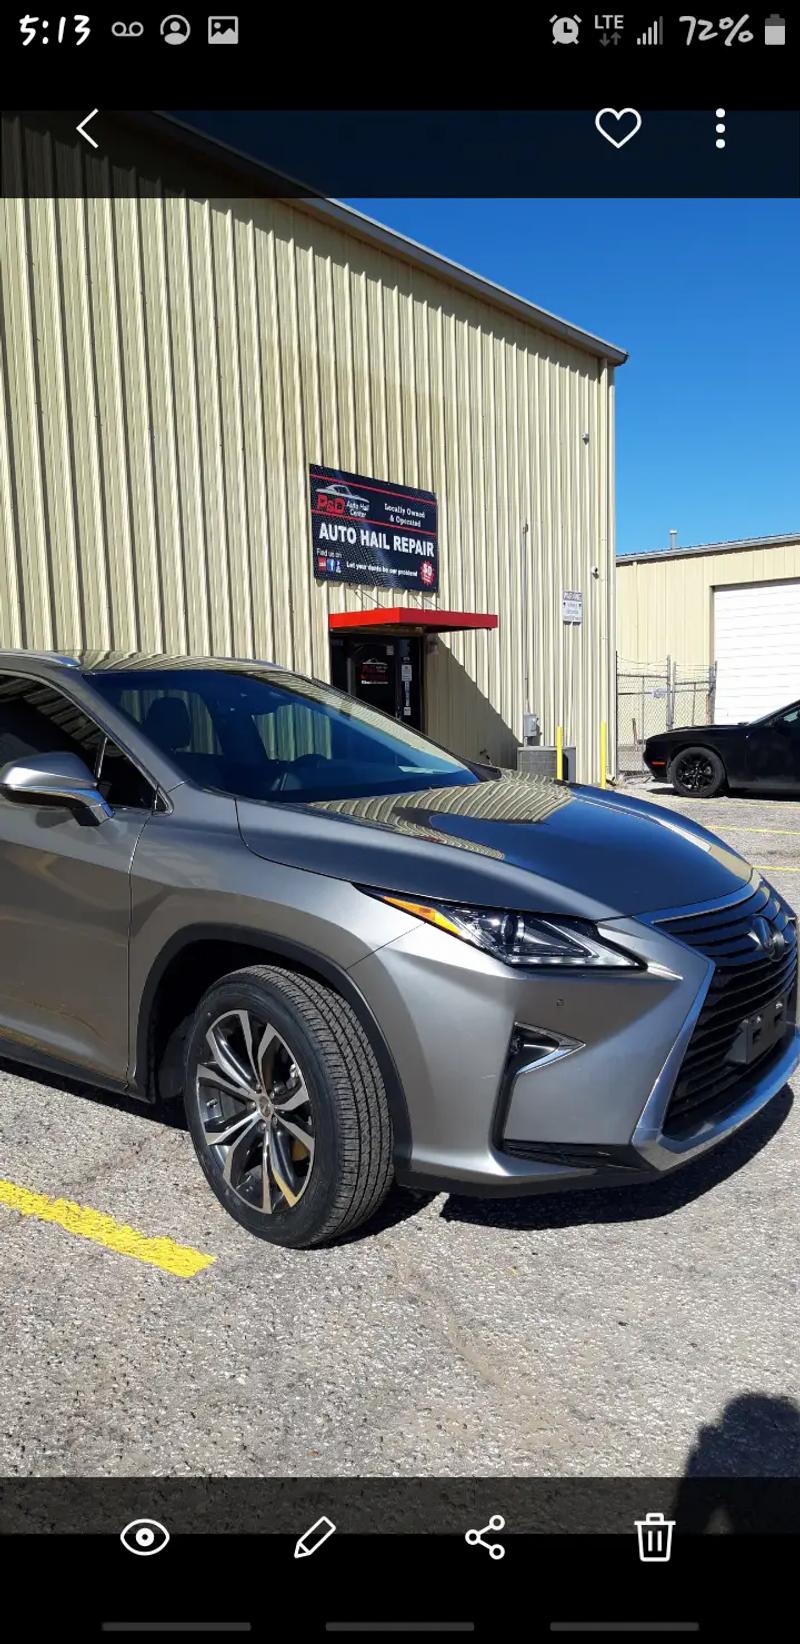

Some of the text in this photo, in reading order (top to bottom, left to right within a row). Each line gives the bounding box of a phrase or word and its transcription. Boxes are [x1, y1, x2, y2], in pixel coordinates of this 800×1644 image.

[384, 503, 425, 519] Locally Owned
[395, 515, 421, 528] Operated
[319, 522, 435, 557] AUTO HAIL REPAIR
